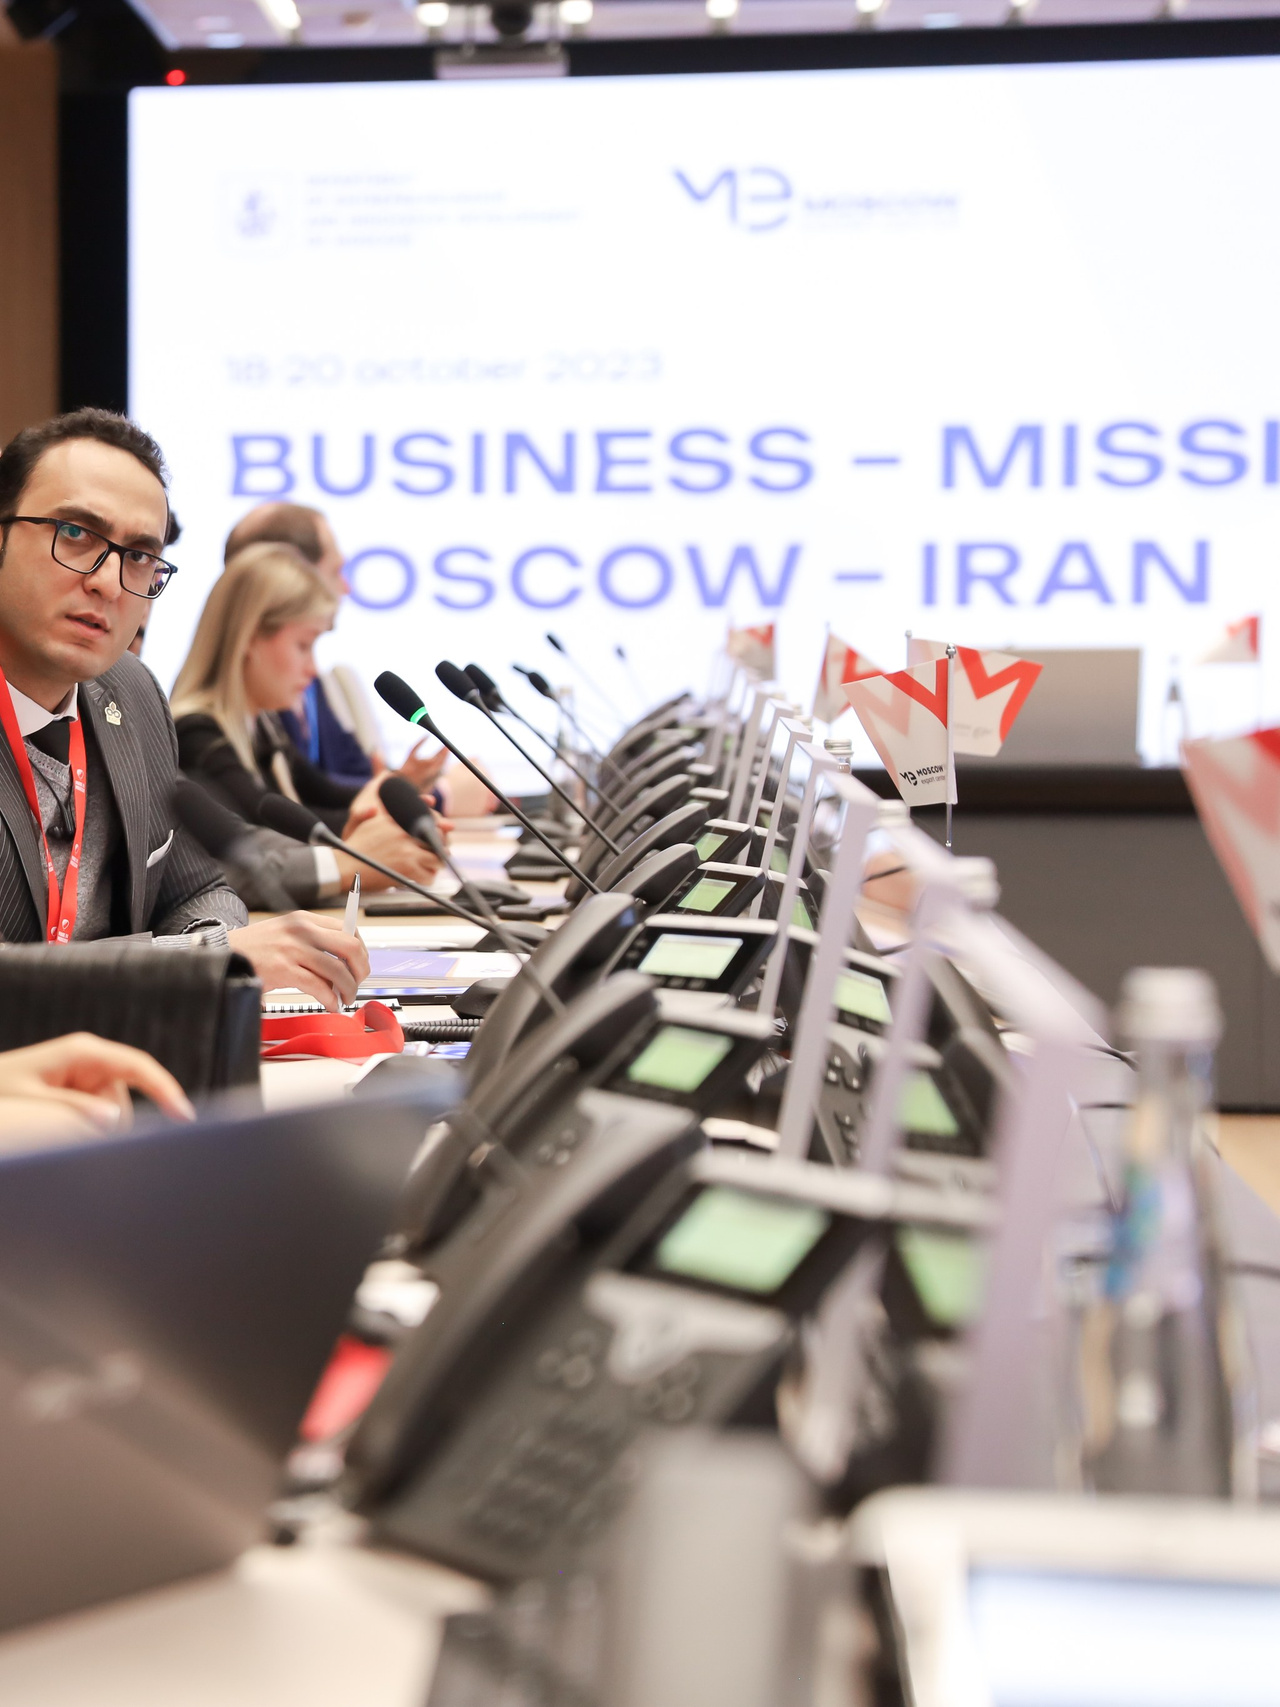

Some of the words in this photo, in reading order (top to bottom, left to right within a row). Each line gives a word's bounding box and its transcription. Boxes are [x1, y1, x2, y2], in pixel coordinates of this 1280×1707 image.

[354, 356, 525, 385] october
[546, 351, 662, 382] 2023
[230, 426, 814, 500] BUSINESS
[941, 418, 1280, 489] MISSI
[341, 543, 802, 612] OSCOW
[922, 539, 1209, 607] IRAN
[916, 765, 944, 777] MOSCOW
